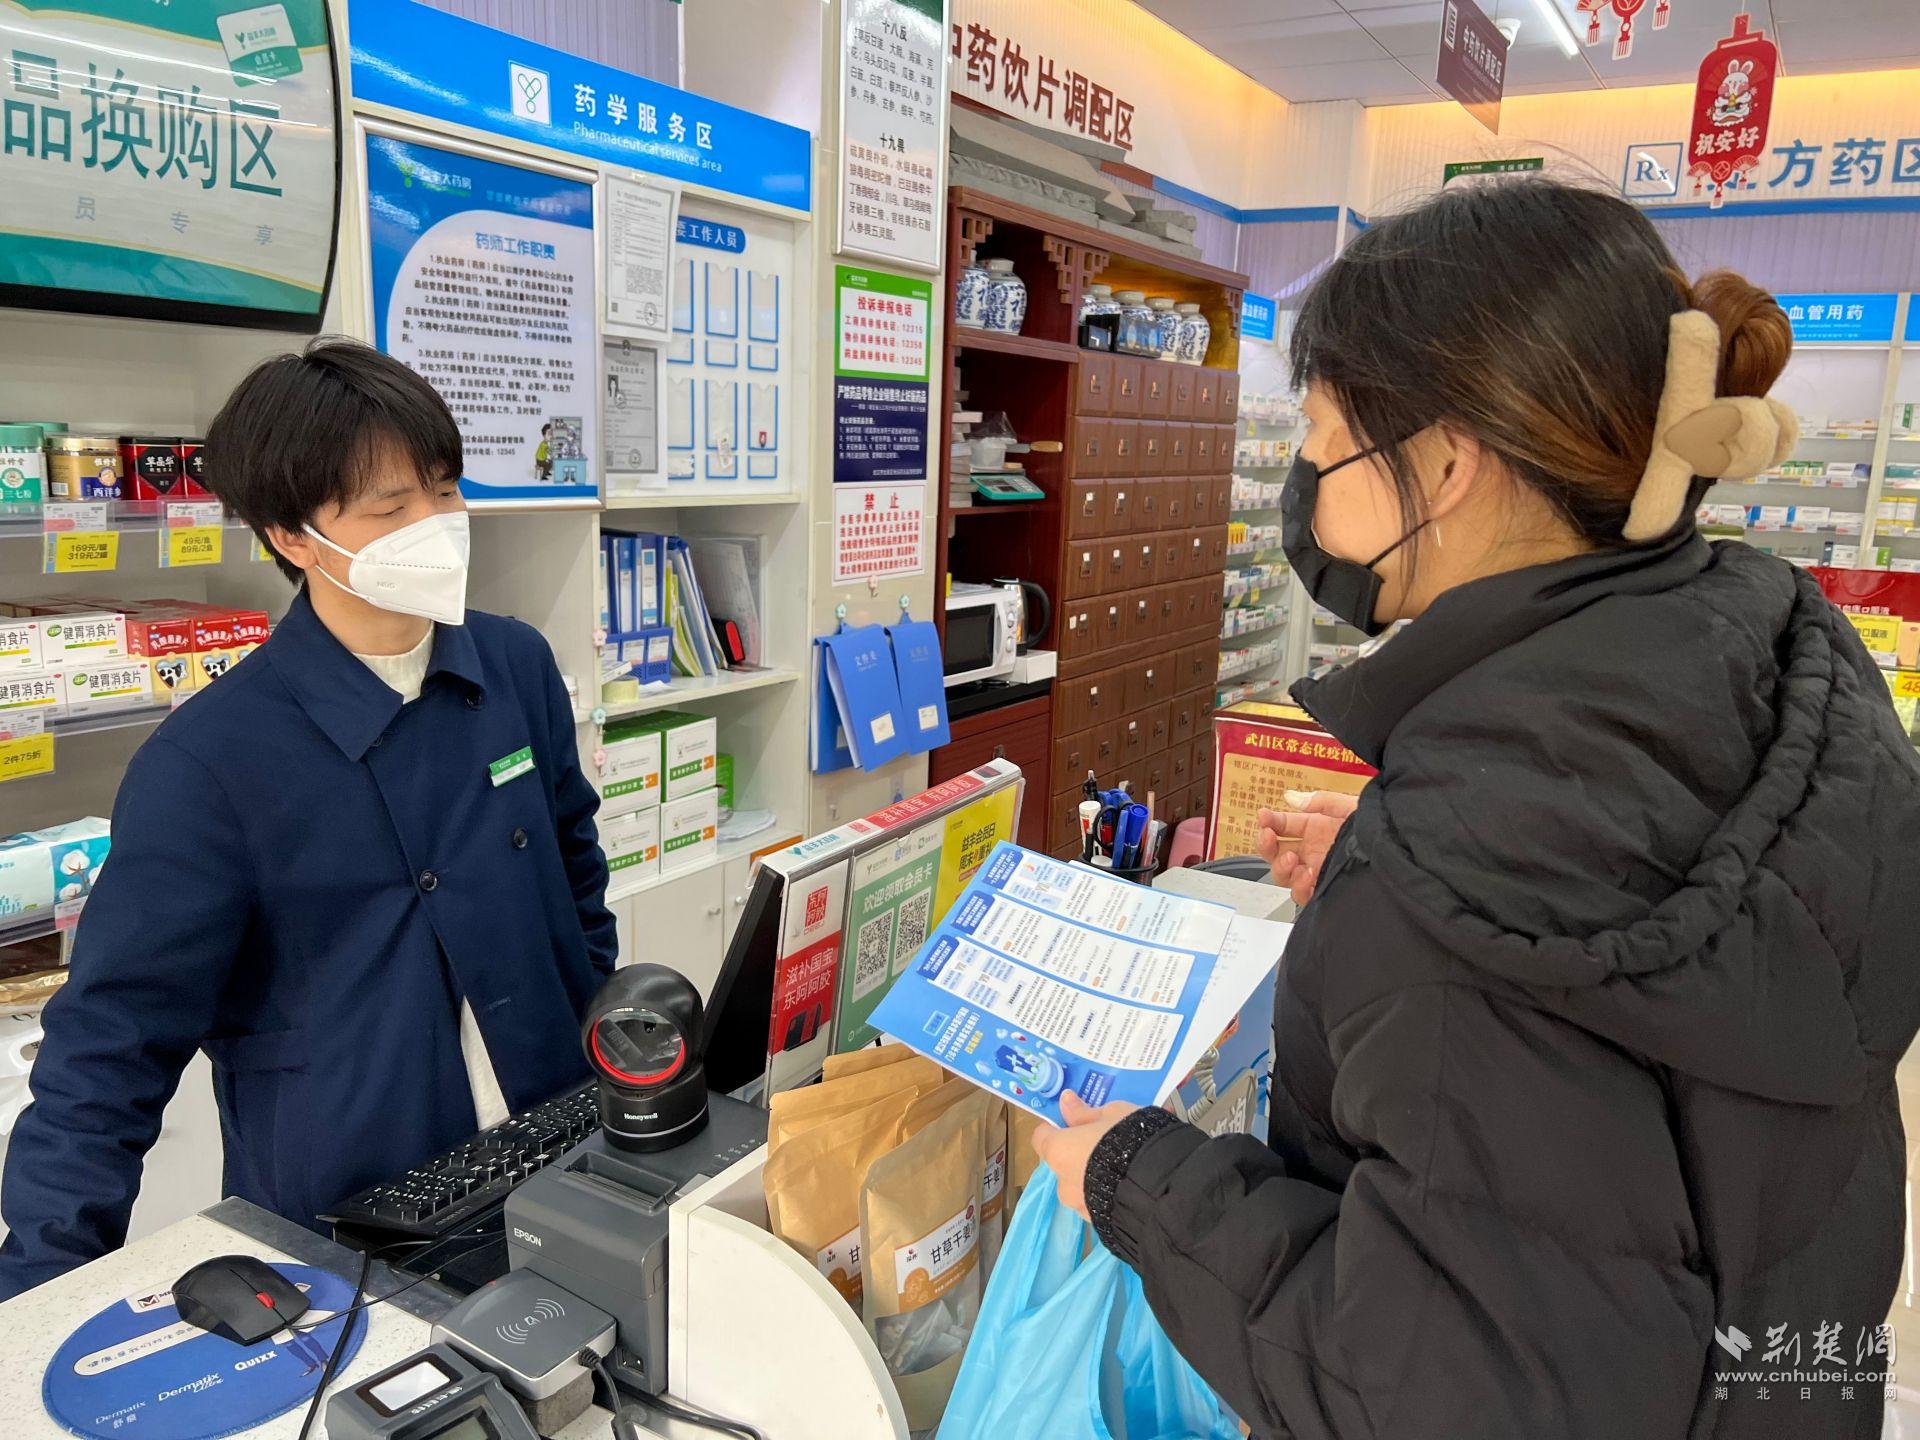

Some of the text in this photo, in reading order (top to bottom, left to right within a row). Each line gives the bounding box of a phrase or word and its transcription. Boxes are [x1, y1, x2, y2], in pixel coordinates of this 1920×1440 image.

[882, 18, 907, 41] 十八反
[952, 23, 1134, 151] 药饮片调配区
[4, 50, 282, 197] 品换购区
[574, 83, 713, 150] 药学服务区
[573, 121, 722, 172] Pharmaceutical services area
[880, 132, 904, 154] 十九畏
[1695, 126, 1760, 156] 祝安好
[1706, 137, 1920, 191] 方药区
[475, 232, 556, 260] 药师工作职责
[1781, 304, 1864, 321] 血管用药
[93, 487, 121, 497] 西洋参
[63, 623, 116, 640] 健胃消食片
[89, 670, 142, 689] 健胃消食片
[862, 862, 933, 914] 欢迎领取会员卡
[786, 947, 833, 988] 滋补国宝
[783, 969, 831, 1010] 东阿阿胶
[514, 1227, 542, 1246] EPSON
[158, 1373, 220, 1401] Dermatix
[95, 1401, 147, 1425] Dermatix
